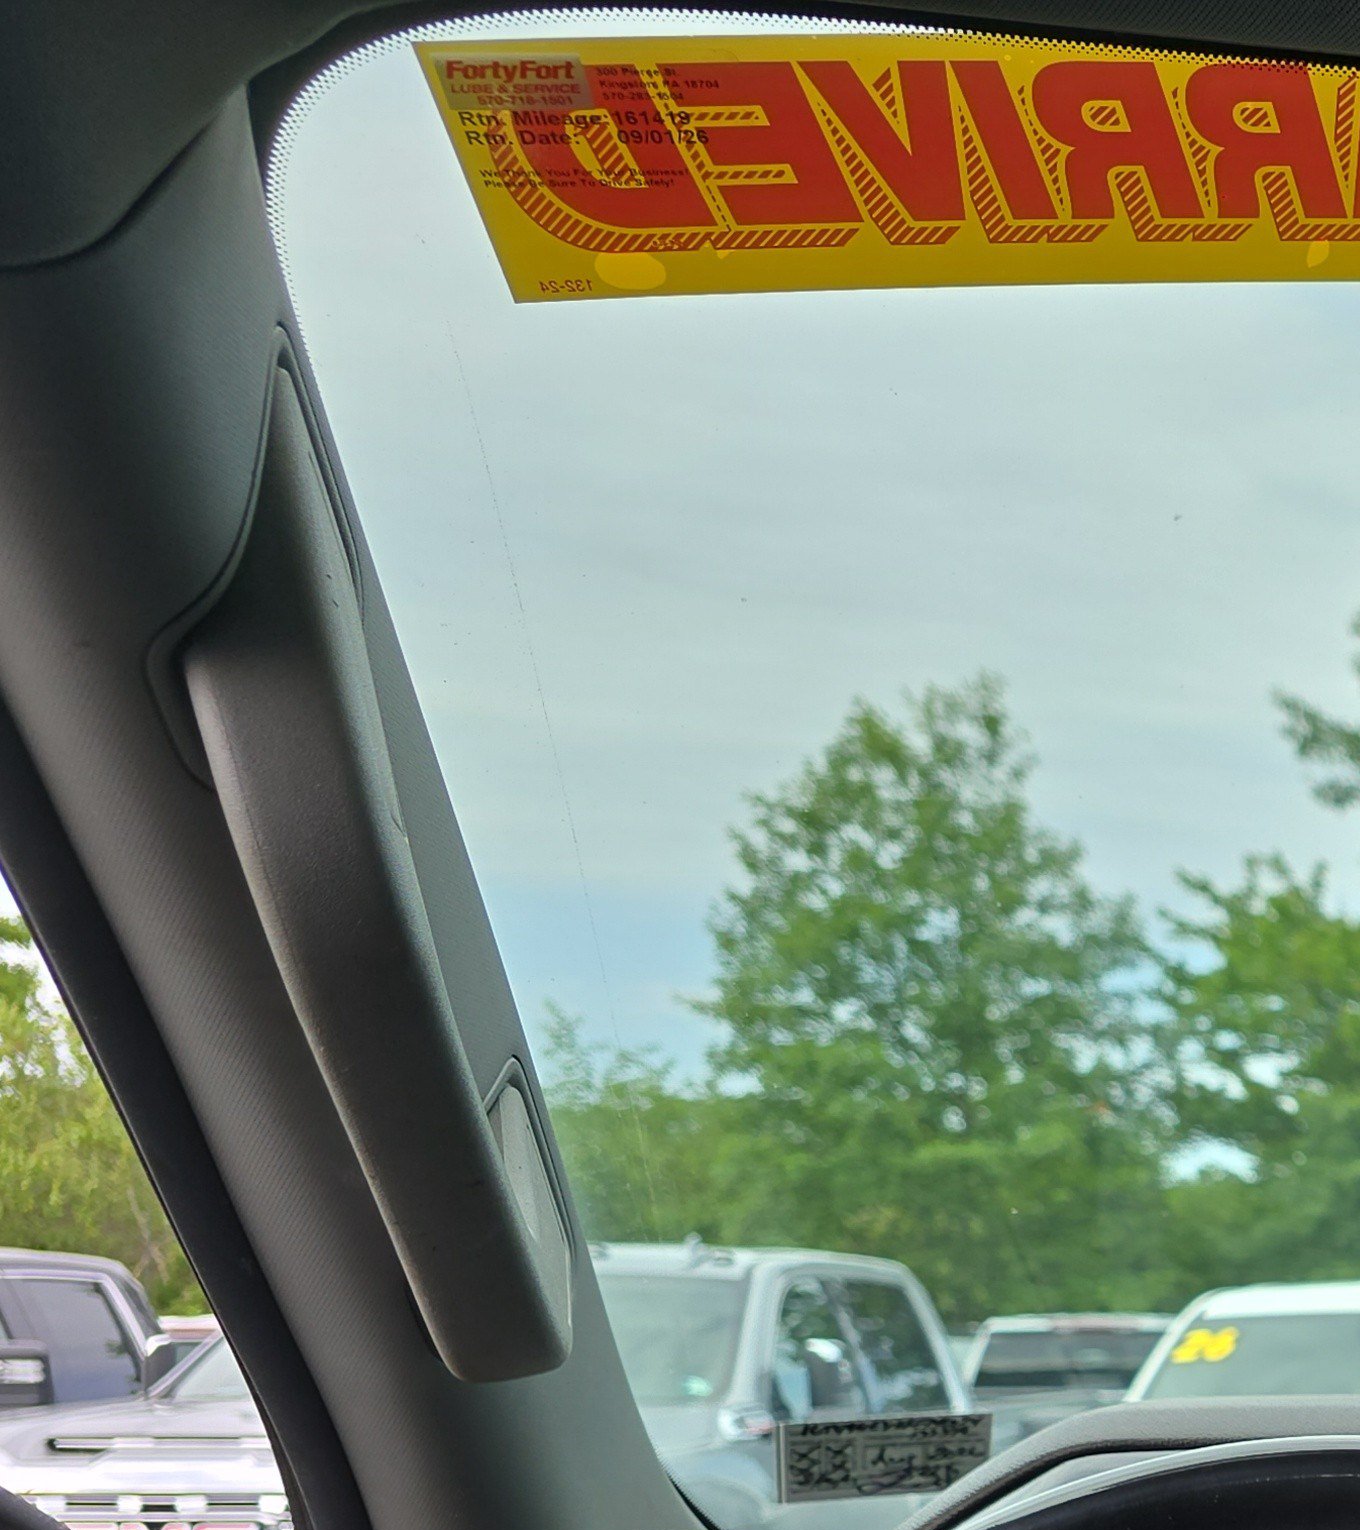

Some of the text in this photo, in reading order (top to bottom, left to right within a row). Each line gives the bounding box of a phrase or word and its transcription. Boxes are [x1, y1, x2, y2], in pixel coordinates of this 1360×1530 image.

[446, 60, 574, 82] FortyFort
[451, 84, 494, 94] LUBE
[513, 84, 580, 94] SERVICE
[457, 110, 691, 129] Rtn. Mileage: 161419
[466, 129, 709, 145] Rtn. Date: 09/01/26
[1170, 1326, 1239, 1363] 26
